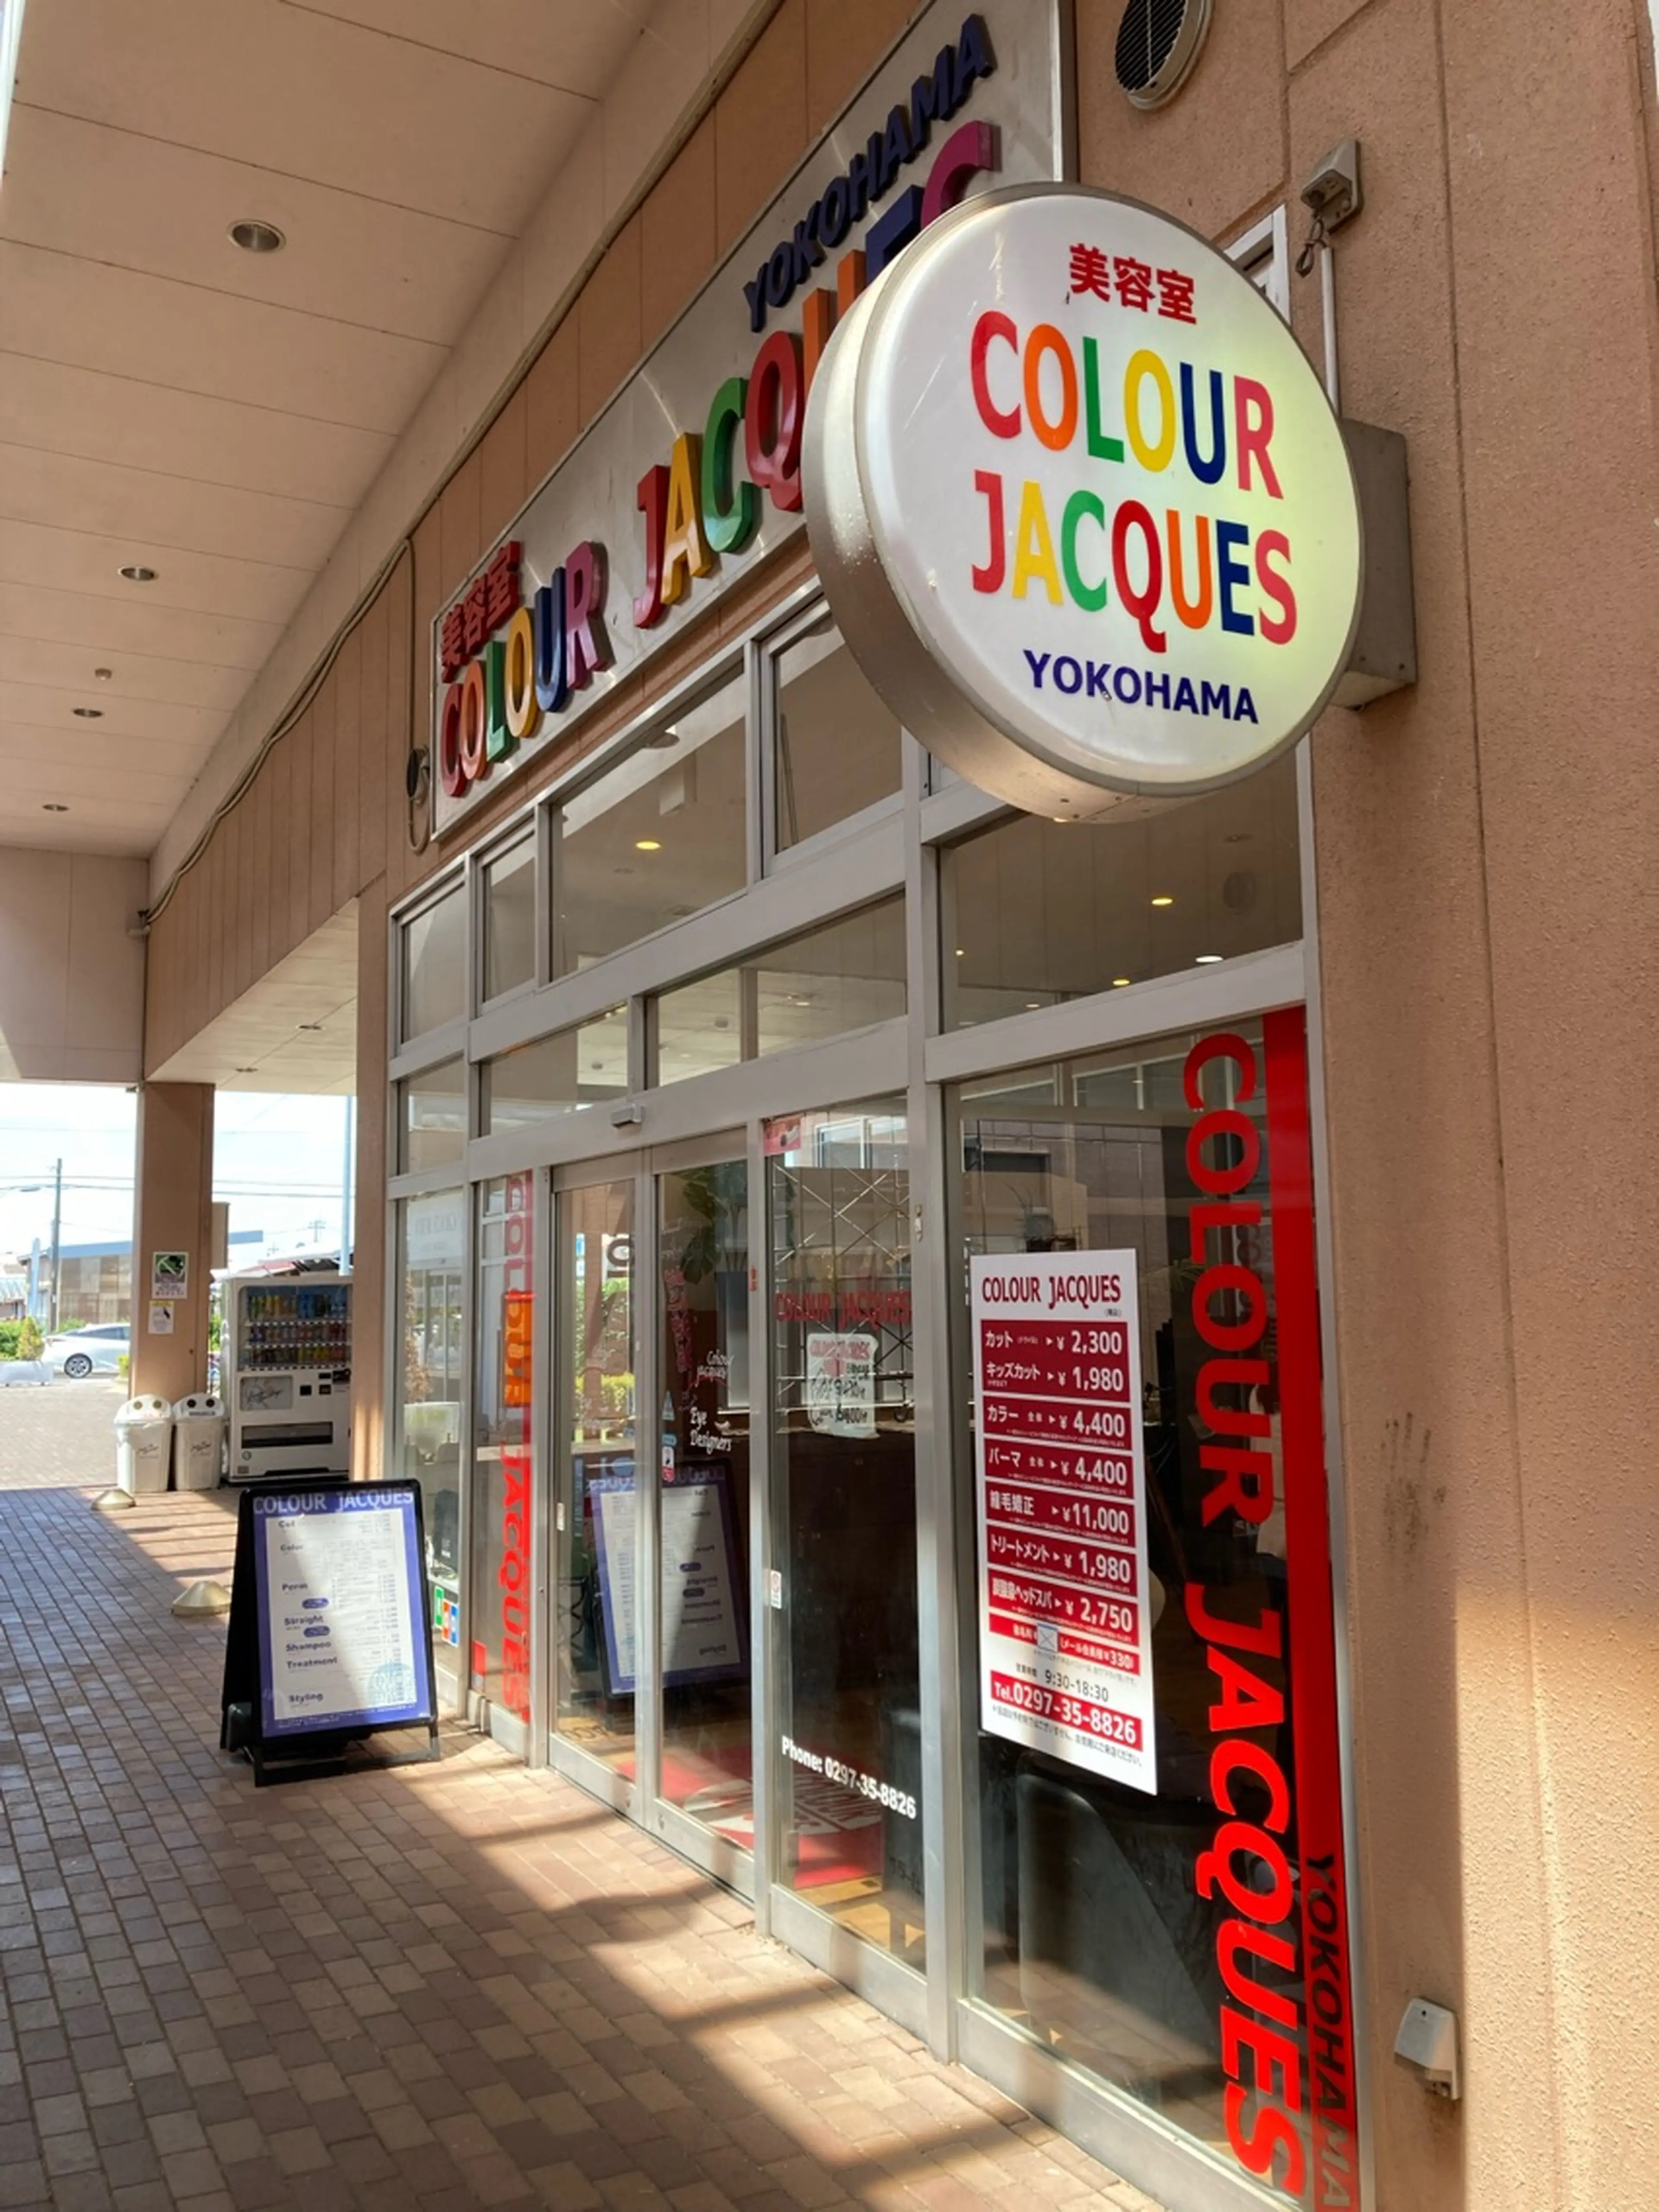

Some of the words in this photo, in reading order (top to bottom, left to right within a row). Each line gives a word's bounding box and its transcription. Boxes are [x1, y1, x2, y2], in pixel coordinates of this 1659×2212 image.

[744, 13, 997, 333] YOKOHAMA
[1068, 243, 1197, 325] 美容室
[970, 310, 1284, 499] COLOUR
[971, 469, 1298, 653] JACQUES
[442, 541, 521, 682] 美容室
[441, 540, 610, 797] COLOUR
[1023, 649, 1259, 724] YOKOHAMA
[982, 1277, 1041, 1303] COLOUR
[1048, 1274, 1121, 1310] JACQUES
[1183, 1033, 1274, 1528] COLOUR
[985, 1330, 1014, 1348] カット
[986, 1361, 1041, 1381] キッズカット
[690, 1406, 707, 1431] Eye
[987, 1404, 1019, 1423] カラー
[690, 1429, 732, 1455] Designers
[252, 1493, 327, 1515] COLOUR
[334, 1487, 413, 1513] JACQUES
[991, 1534, 1050, 1564] トリートメント
[499, 1438, 528, 1710] JACQUES
[283, 1615, 324, 1626] Straight
[285, 1641, 332, 1652] Shampoo
[286, 1656, 338, 1669] Treatment
[289, 1693, 324, 1704] Styling
[1045, 1669, 1109, 1703] 9:30-18:30
[782, 1735, 823, 1773] Phone:
[824, 1756, 916, 1819] 0297-35-8826
[1184, 1583, 1307, 2196] JACQUES
[1305, 1850, 1349, 2210] YOKOHAMA
